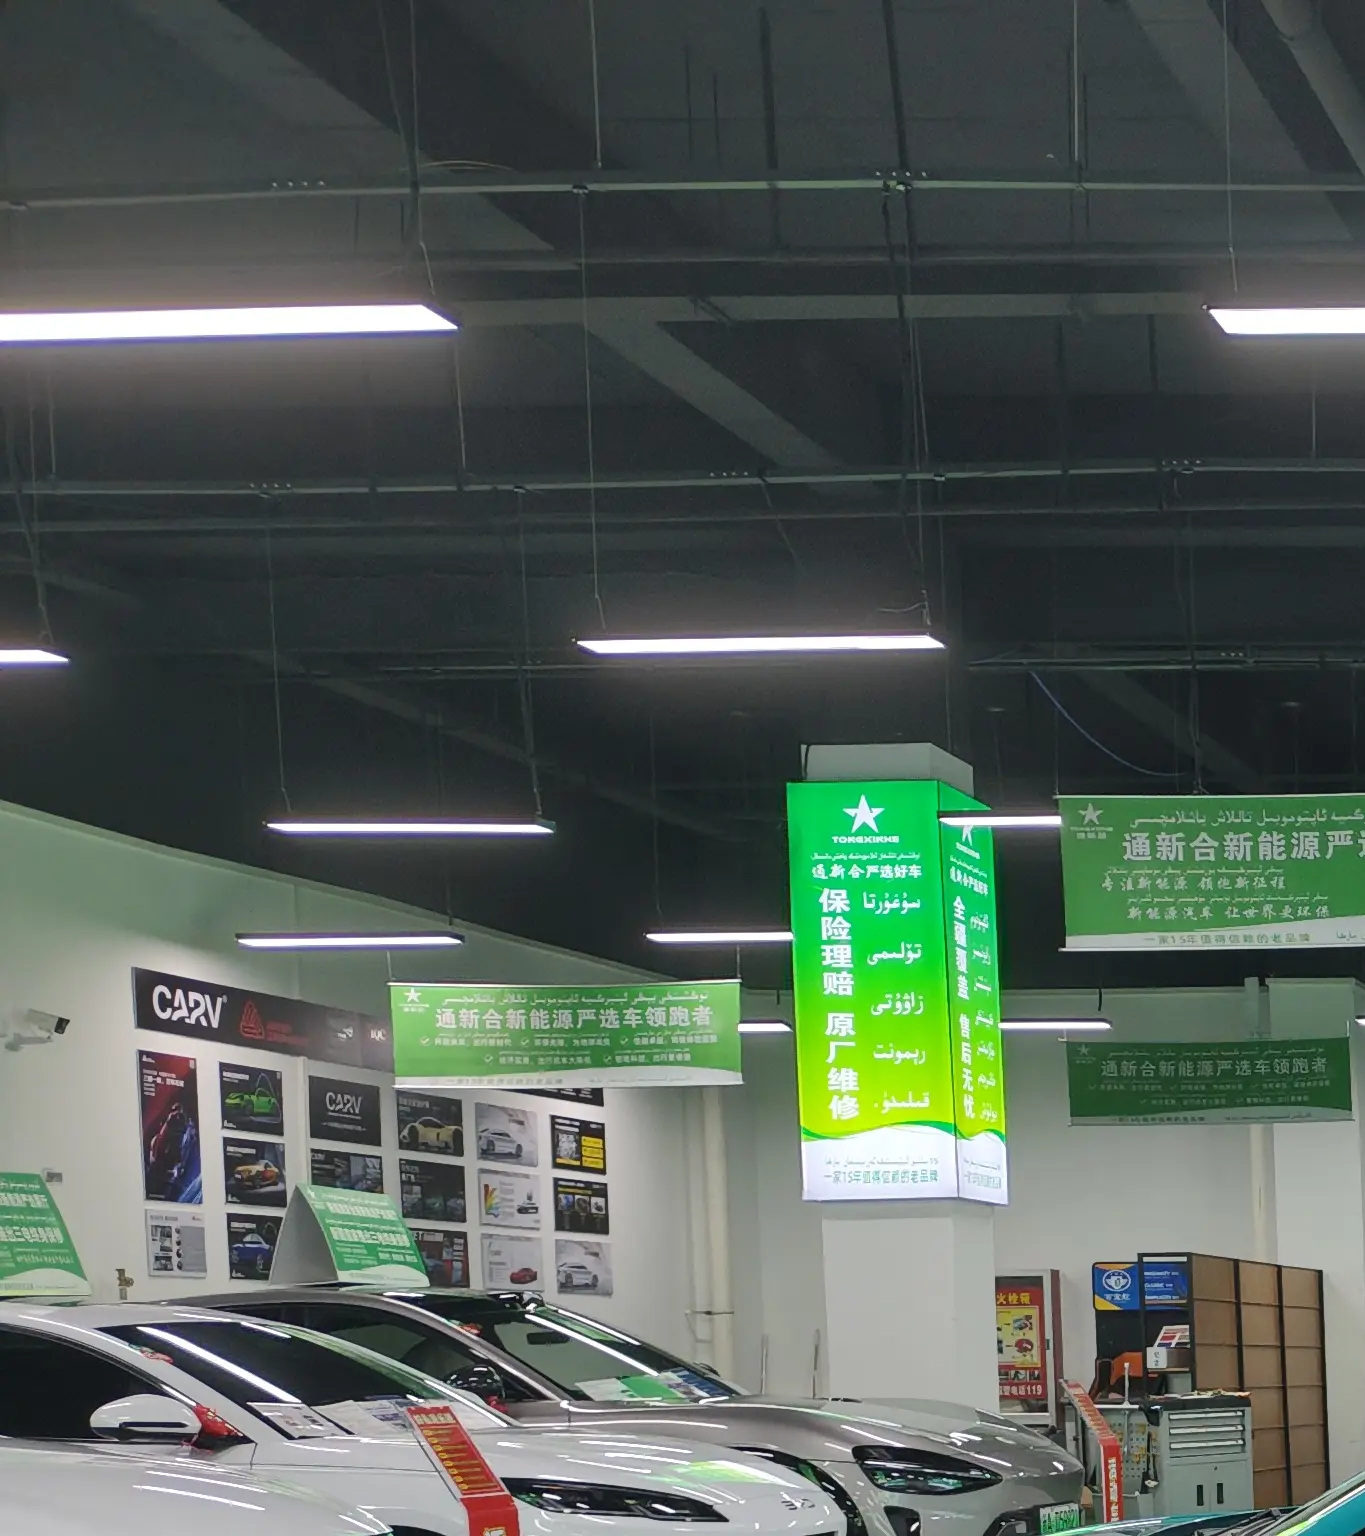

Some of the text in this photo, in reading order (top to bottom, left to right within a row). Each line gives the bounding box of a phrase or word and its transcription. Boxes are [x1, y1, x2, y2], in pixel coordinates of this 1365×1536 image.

[818, 887, 861, 1121] 保险理赔 原厂维修
[436, 1005, 714, 1030] 通新合新能源严选车领跑者
[1101, 1056, 1329, 1078] 通新合新能源严选车领跑者
